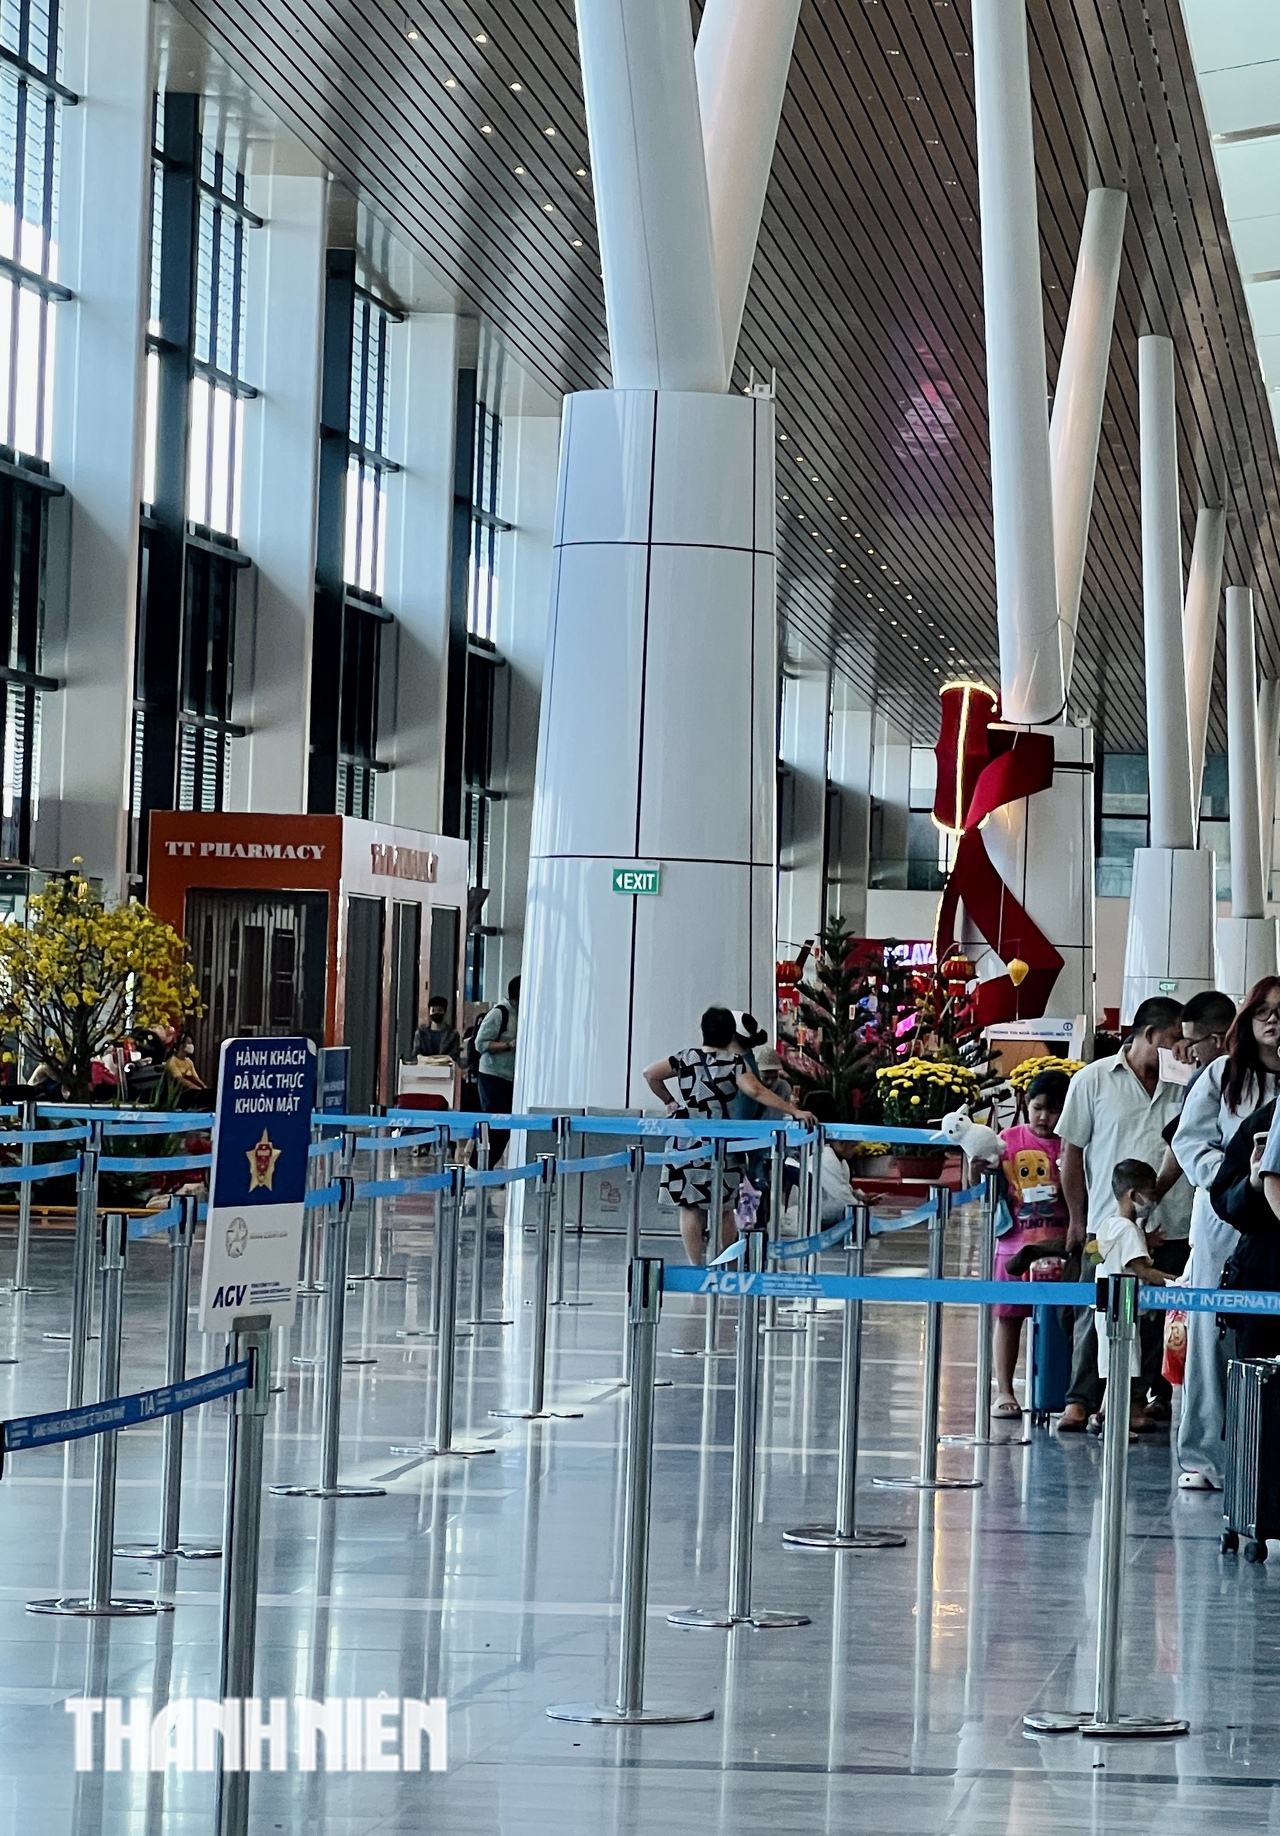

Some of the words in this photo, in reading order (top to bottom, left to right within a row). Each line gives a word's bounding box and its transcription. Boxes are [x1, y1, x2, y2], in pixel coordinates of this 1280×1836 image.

[165, 841, 196, 856] TT
[200, 842, 326, 860] PHARMACY
[624, 873, 656, 890] EXIT
[235, 1046, 268, 1066] HÀNH
[270, 1045, 306, 1066] KHÁCH
[234, 1070, 250, 1090] ĐÃ
[252, 1070, 274, 1089] XÁC
[276, 1071, 305, 1092] THỰC
[235, 1093, 274, 1114] KHUÔN
[276, 1093, 301, 1116] MẶT
[700, 1272, 757, 1294] ACV
[212, 1285, 248, 1309] ACV
[1155, 1292, 1195, 1306] NHAT
